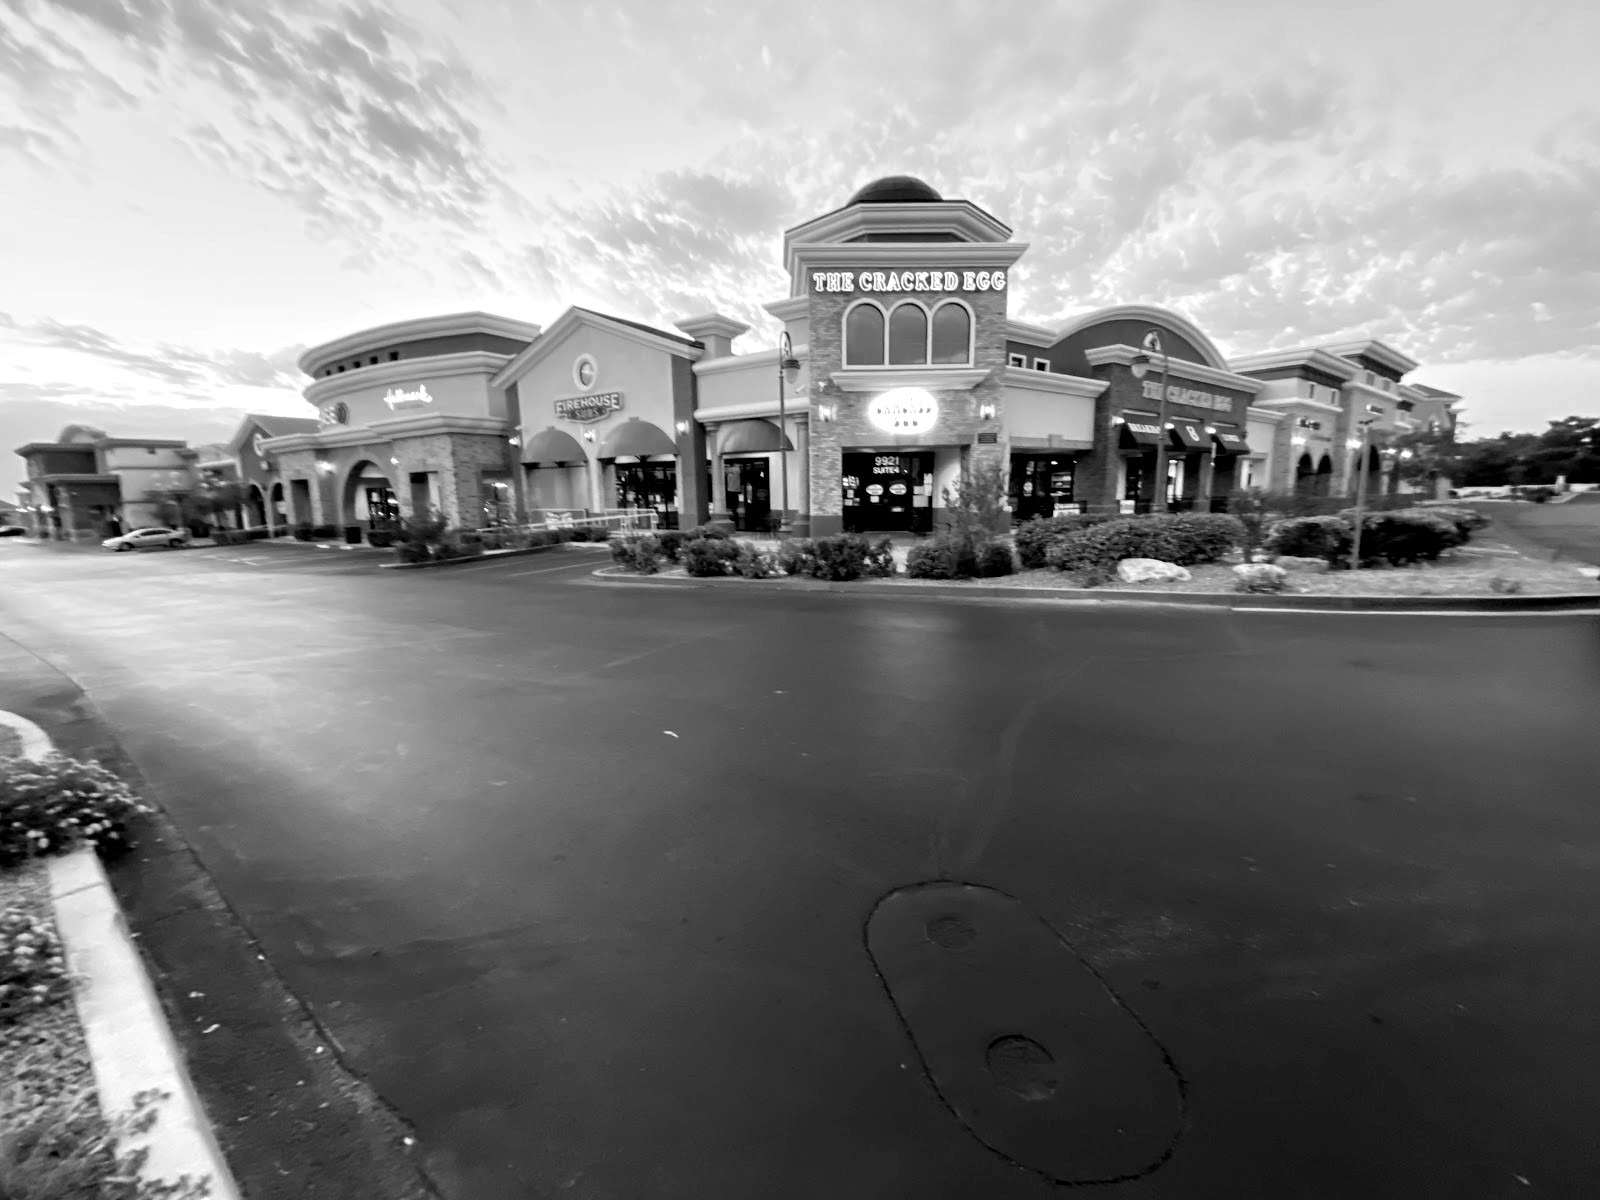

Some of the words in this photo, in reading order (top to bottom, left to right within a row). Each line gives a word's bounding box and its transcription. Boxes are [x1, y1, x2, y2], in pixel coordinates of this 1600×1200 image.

[813, 272, 854, 292] THE
[859, 271, 959, 291] CRACKED
[963, 271, 1006, 291] EGG
[556, 394, 620, 415] FIREHOUSE
[875, 456, 900, 466] 9921
[873, 466, 895, 474] SUITE
